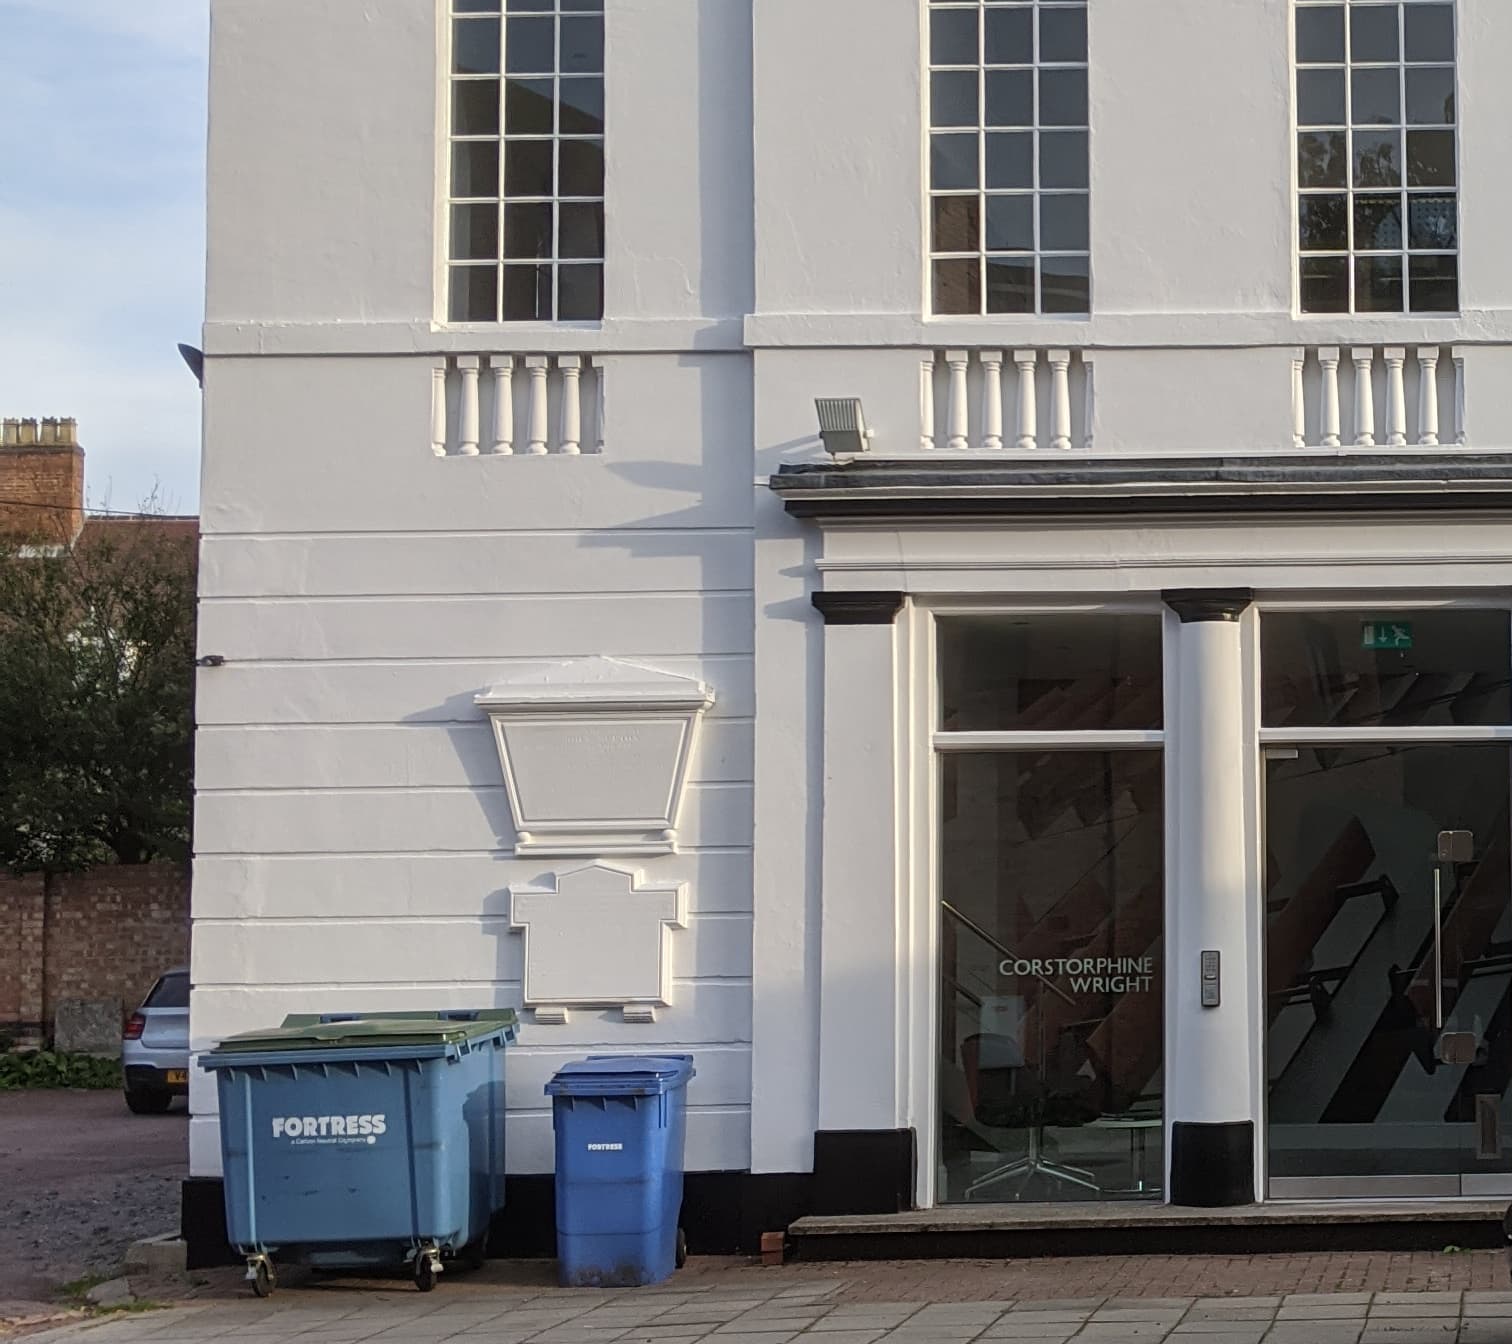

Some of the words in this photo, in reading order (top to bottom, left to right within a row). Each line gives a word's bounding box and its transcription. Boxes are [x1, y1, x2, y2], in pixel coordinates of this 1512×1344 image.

[999, 957, 1153, 976] CORSTORPHINE
[1069, 976, 1154, 993] WRIGHT
[272, 1114, 387, 1138] FORTRESS
